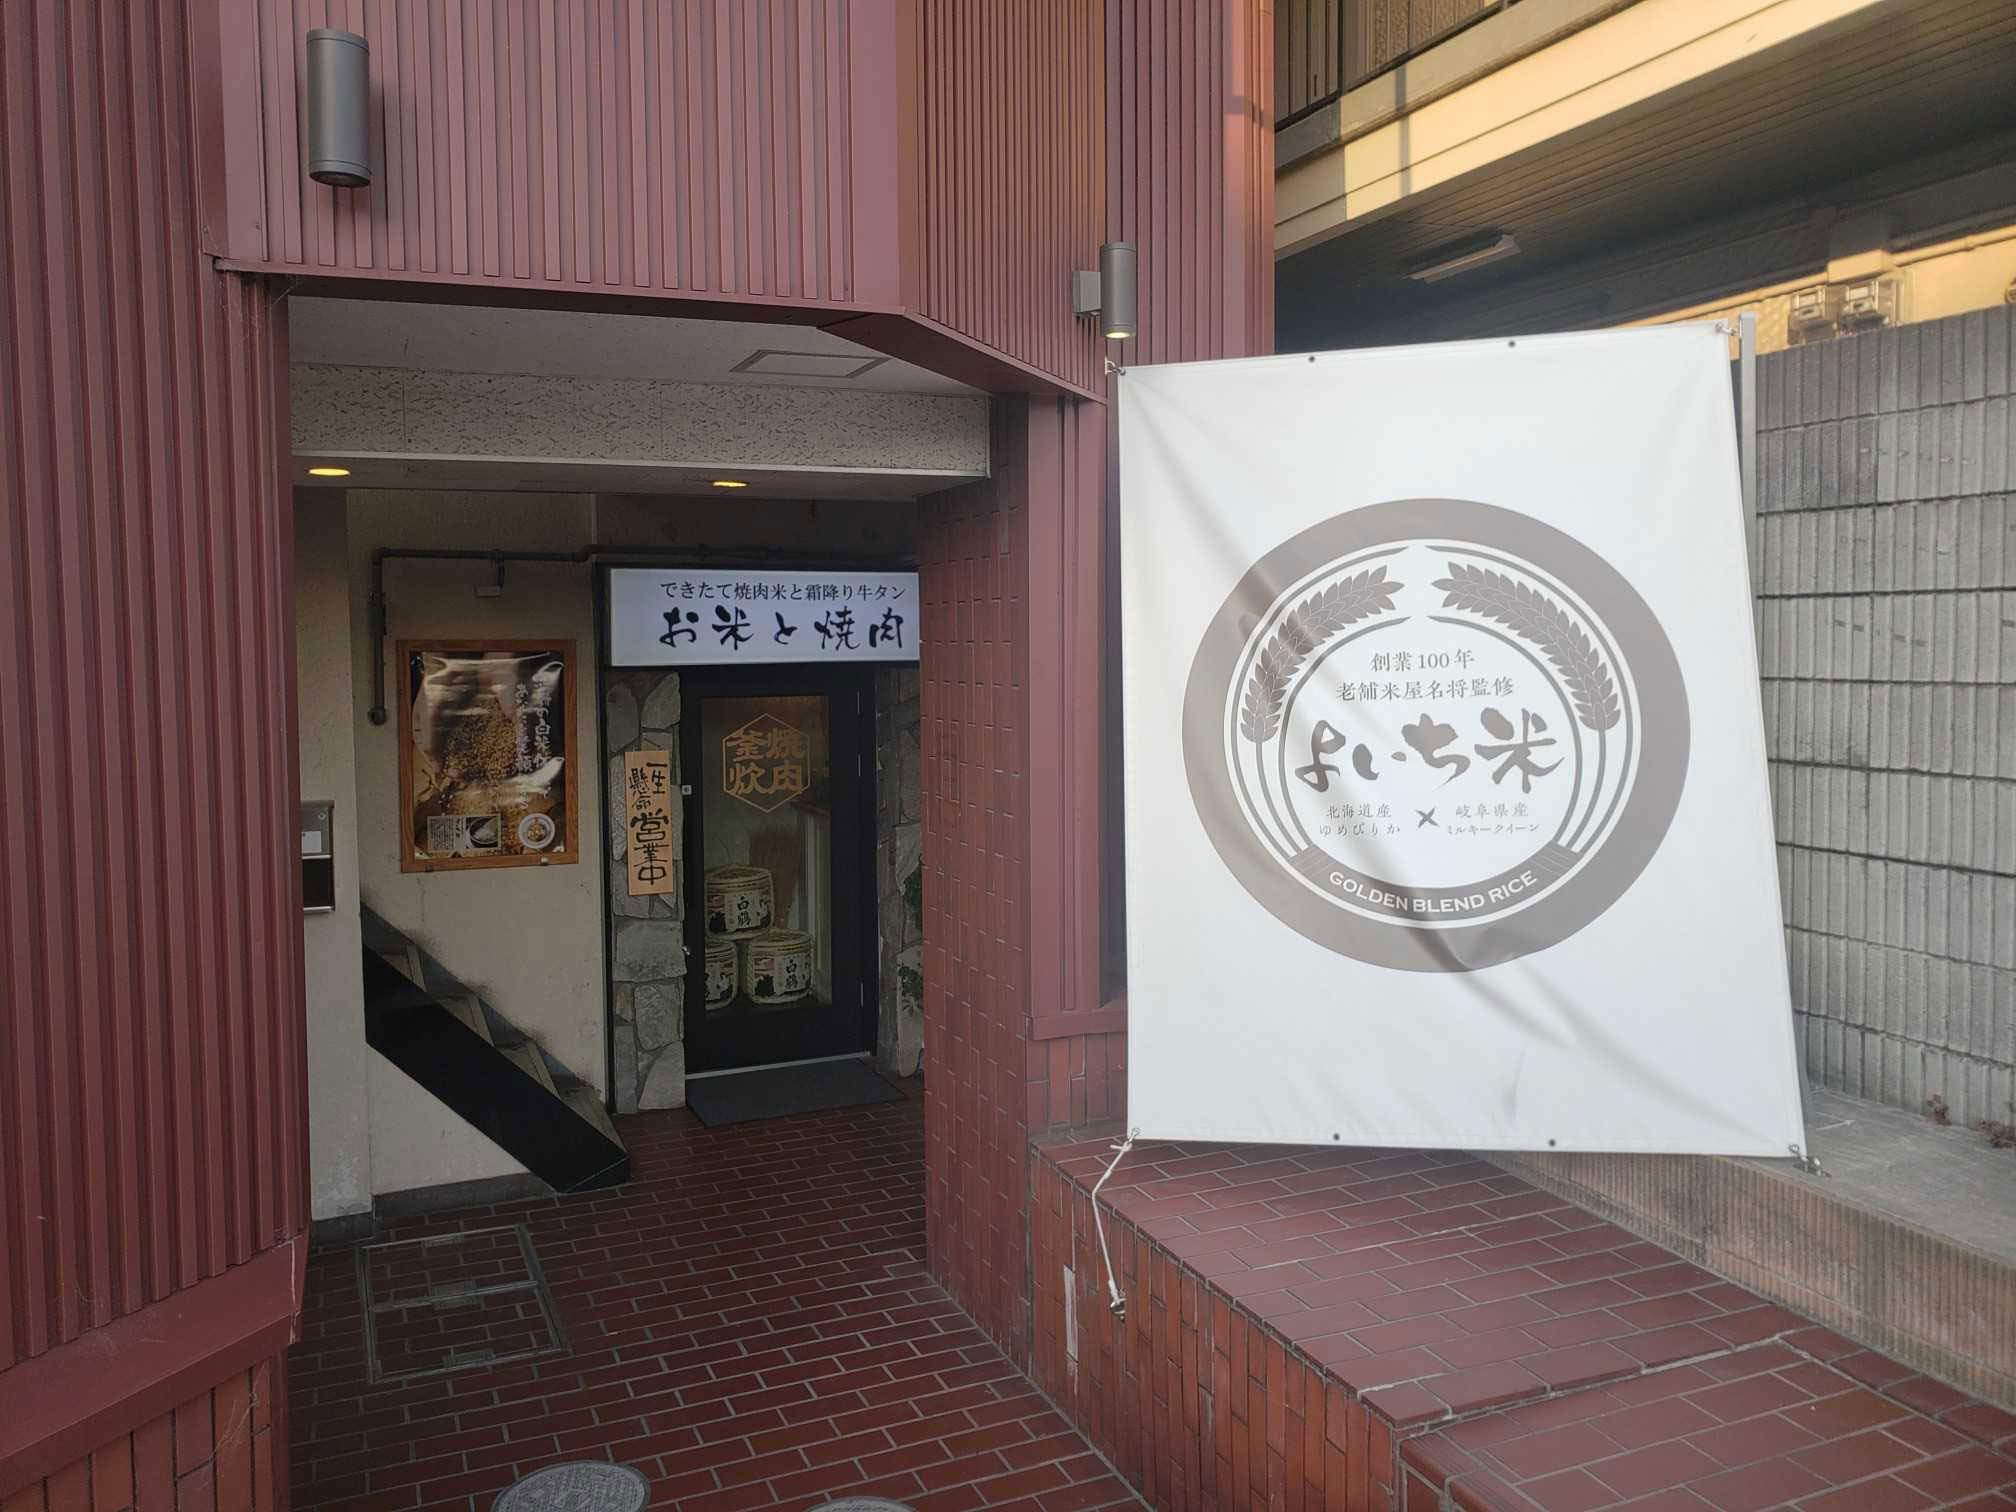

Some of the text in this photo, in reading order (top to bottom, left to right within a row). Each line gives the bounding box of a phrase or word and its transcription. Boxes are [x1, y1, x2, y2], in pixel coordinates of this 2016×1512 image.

[660, 580, 906, 602] できたて焼肉米と霜降り牛タン
[659, 605, 904, 651] お米と焼肉
[1372, 648, 1476, 672] 創業100年
[1336, 676, 1514, 703] 老舗米屋名将監修
[1295, 707, 1565, 794] よいち米
[1326, 801, 1391, 819] 北海道産
[1455, 801, 1529, 819] 岐阜県産
[1448, 822, 1539, 835] ミルキークイーン
[630, 808, 669, 886] 営業中
[1328, 870, 1537, 913] GOLDEN BLEND RICE
